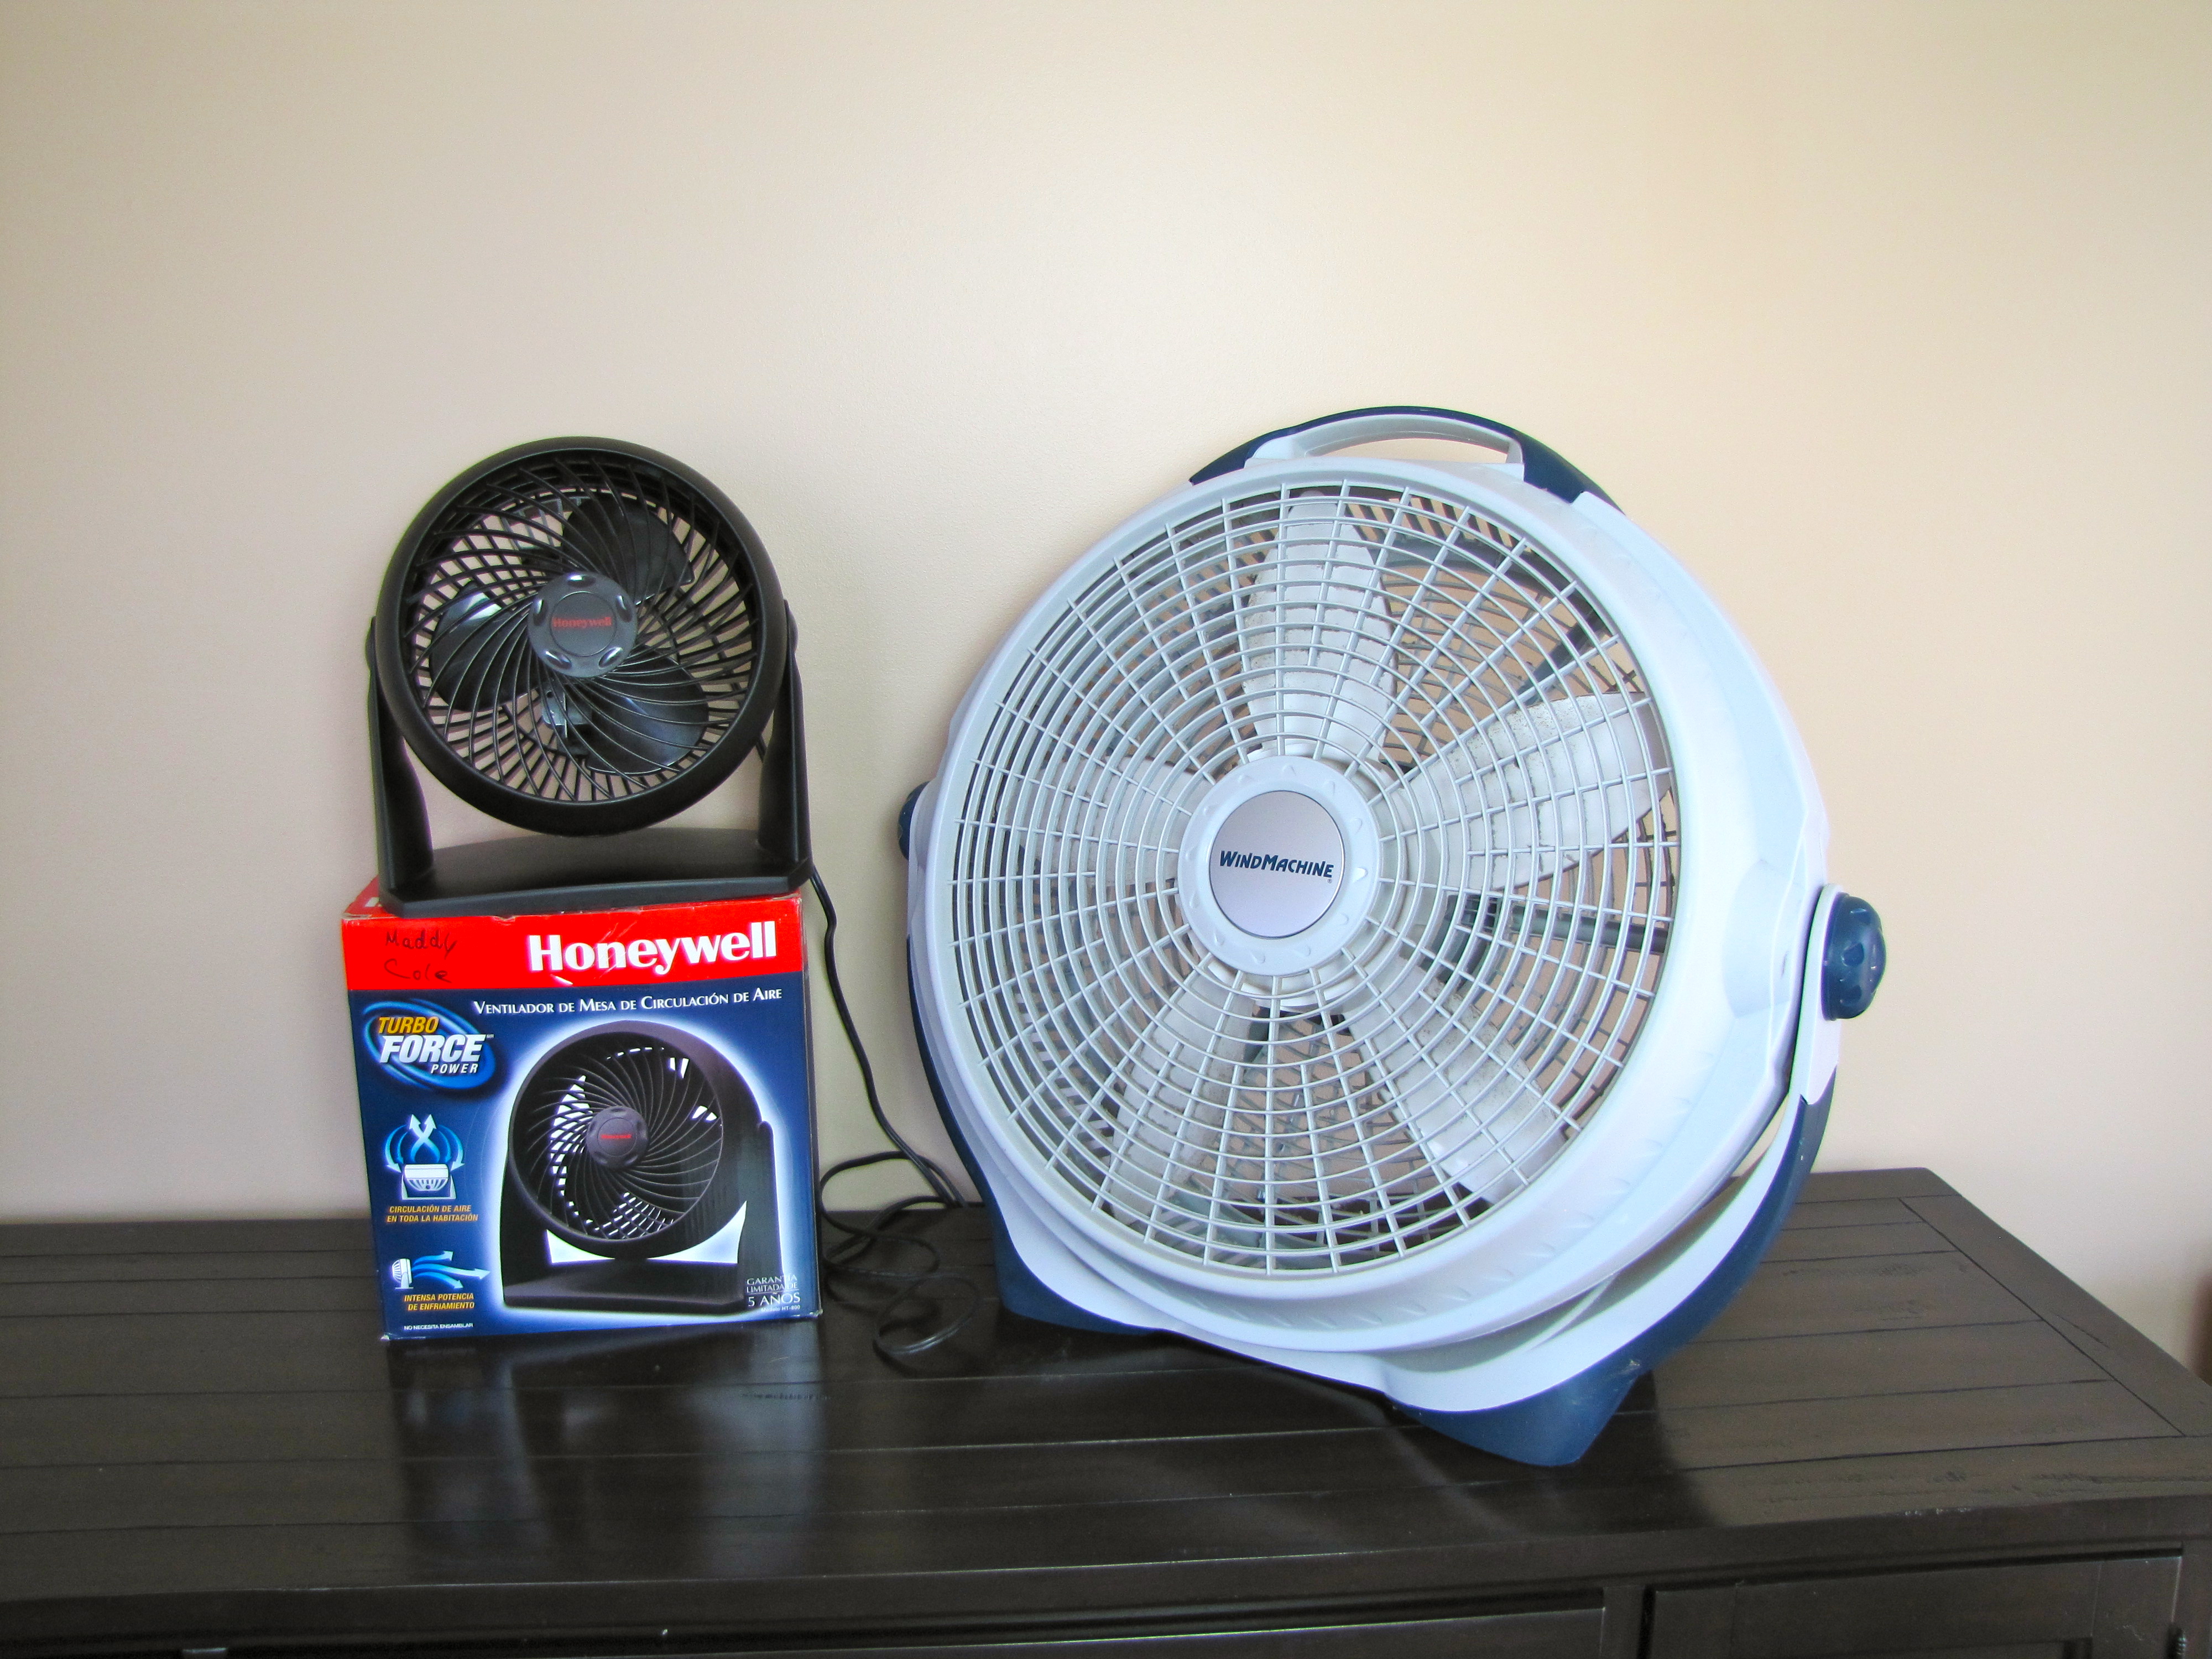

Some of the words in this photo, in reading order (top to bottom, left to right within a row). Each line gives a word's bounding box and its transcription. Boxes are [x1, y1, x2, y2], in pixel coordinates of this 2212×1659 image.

[385, 929, 458, 960] Maddy
[528, 920, 777, 975] Honeywell
[384, 958, 452, 983] Cole
[473, 1000, 554, 1014] VENTILADOR
[559, 1002, 575, 1013] DE
[580, 998, 617, 1011] MESA
[620, 1000, 637, 1010] DE
[641, 993, 729, 1010] CIRCULACIÓN
[733, 992, 749, 1003] DE
[753, 987, 782, 1001] AIRE
[378, 1016, 440, 1034] TURBO
[379, 1034, 487, 1063] FORCE
[430, 1063, 479, 1074] POWER
[389, 1204, 440, 1213] CIRCULACIÓN
[432, 1213, 478, 1222] HABITACIÓN
[747, 1284, 785, 1293] LIMITADA
[408, 1303, 418, 1311] DE
[420, 1301, 475, 1311] ENFRIAMIENTO
[748, 1296, 755, 1307] 5
[760, 1292, 801, 1306] AÑOS
